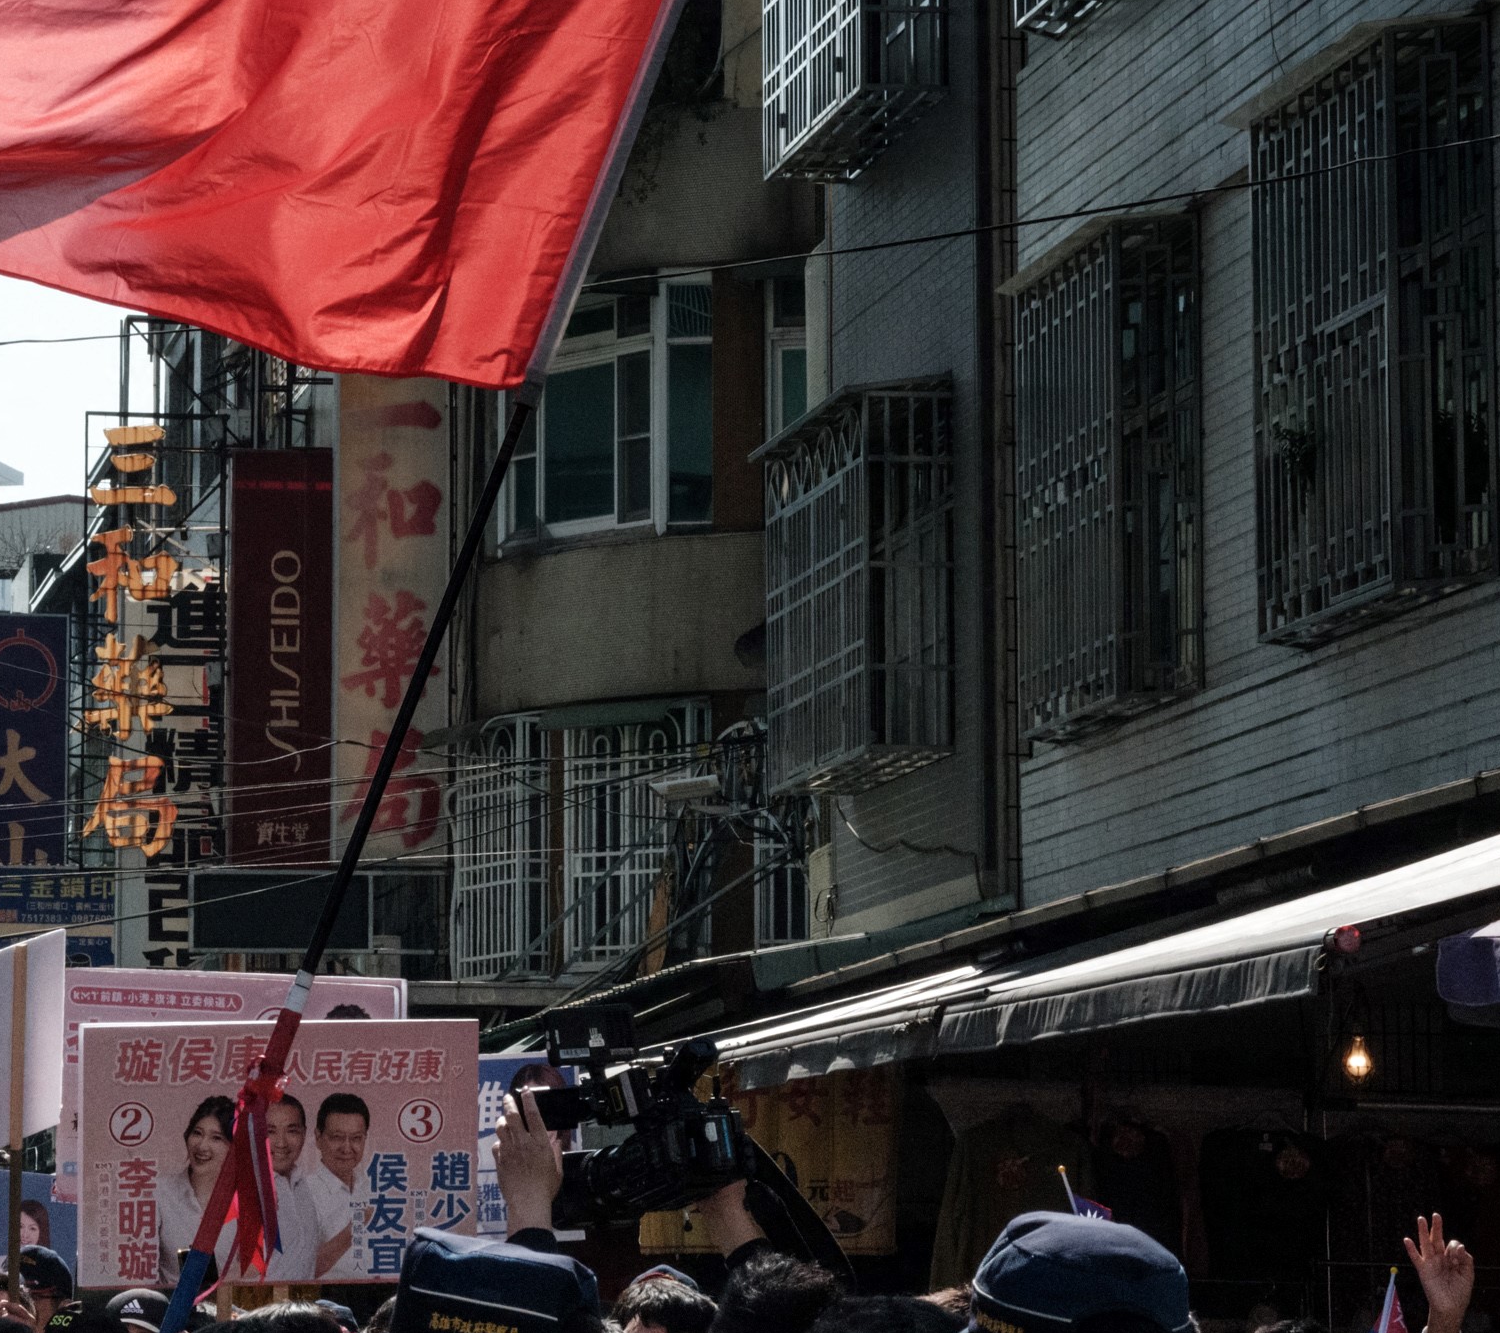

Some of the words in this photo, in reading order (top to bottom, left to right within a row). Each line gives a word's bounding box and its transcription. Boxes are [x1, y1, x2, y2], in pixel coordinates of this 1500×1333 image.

[265, 548, 303, 773] SHISEIDO
[256, 819, 310, 847] 資生堂
[284, 1049, 444, 1084] 人民有好康
[117, 1157, 158, 1280] 李明璇
[366, 1152, 409, 1275] 侯友宜
[430, 1151, 471, 1231] 趙少
